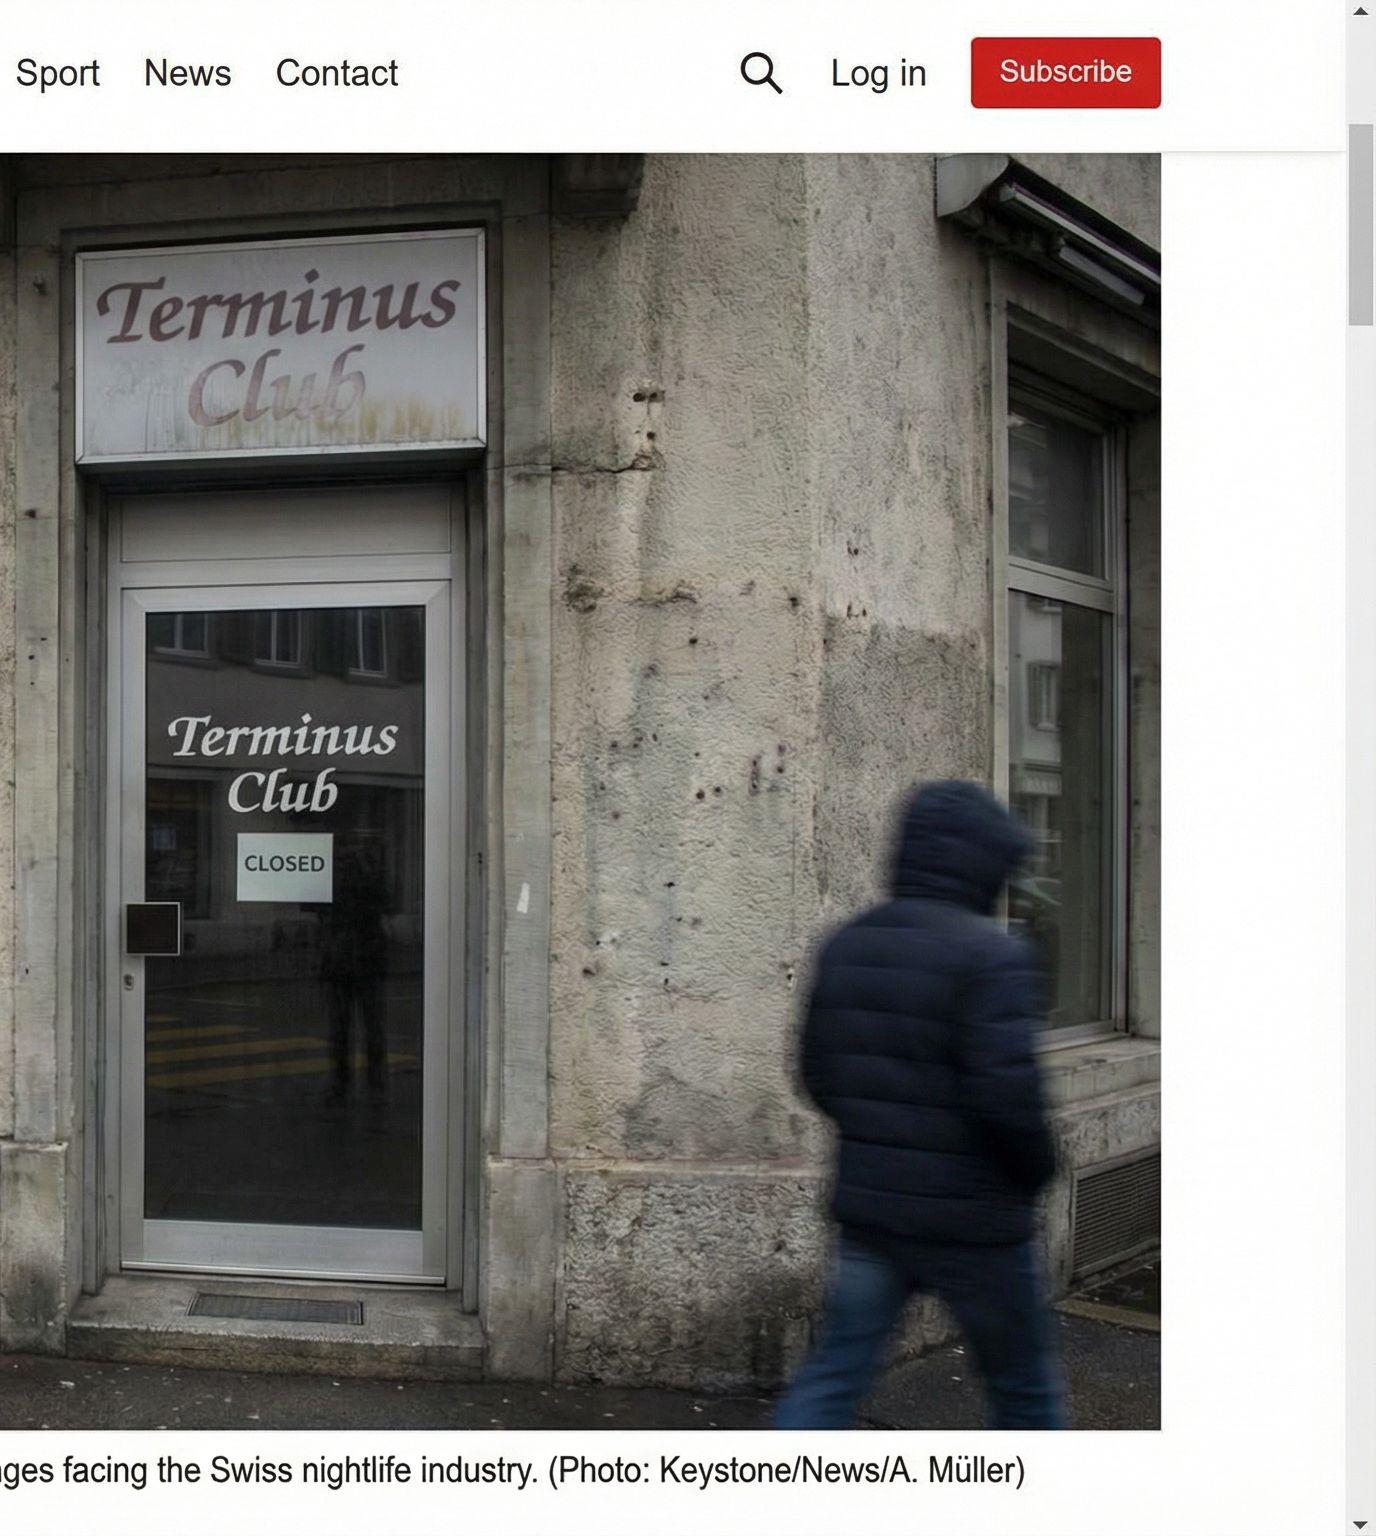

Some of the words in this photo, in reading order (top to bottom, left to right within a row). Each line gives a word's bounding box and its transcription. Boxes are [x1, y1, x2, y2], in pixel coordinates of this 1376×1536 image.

[97, 269, 461, 344] Terminus
[188, 344, 366, 428] Club
[168, 713, 399, 757] Terminus
[228, 767, 339, 813] Club
[244, 855, 325, 873] CLOSED
